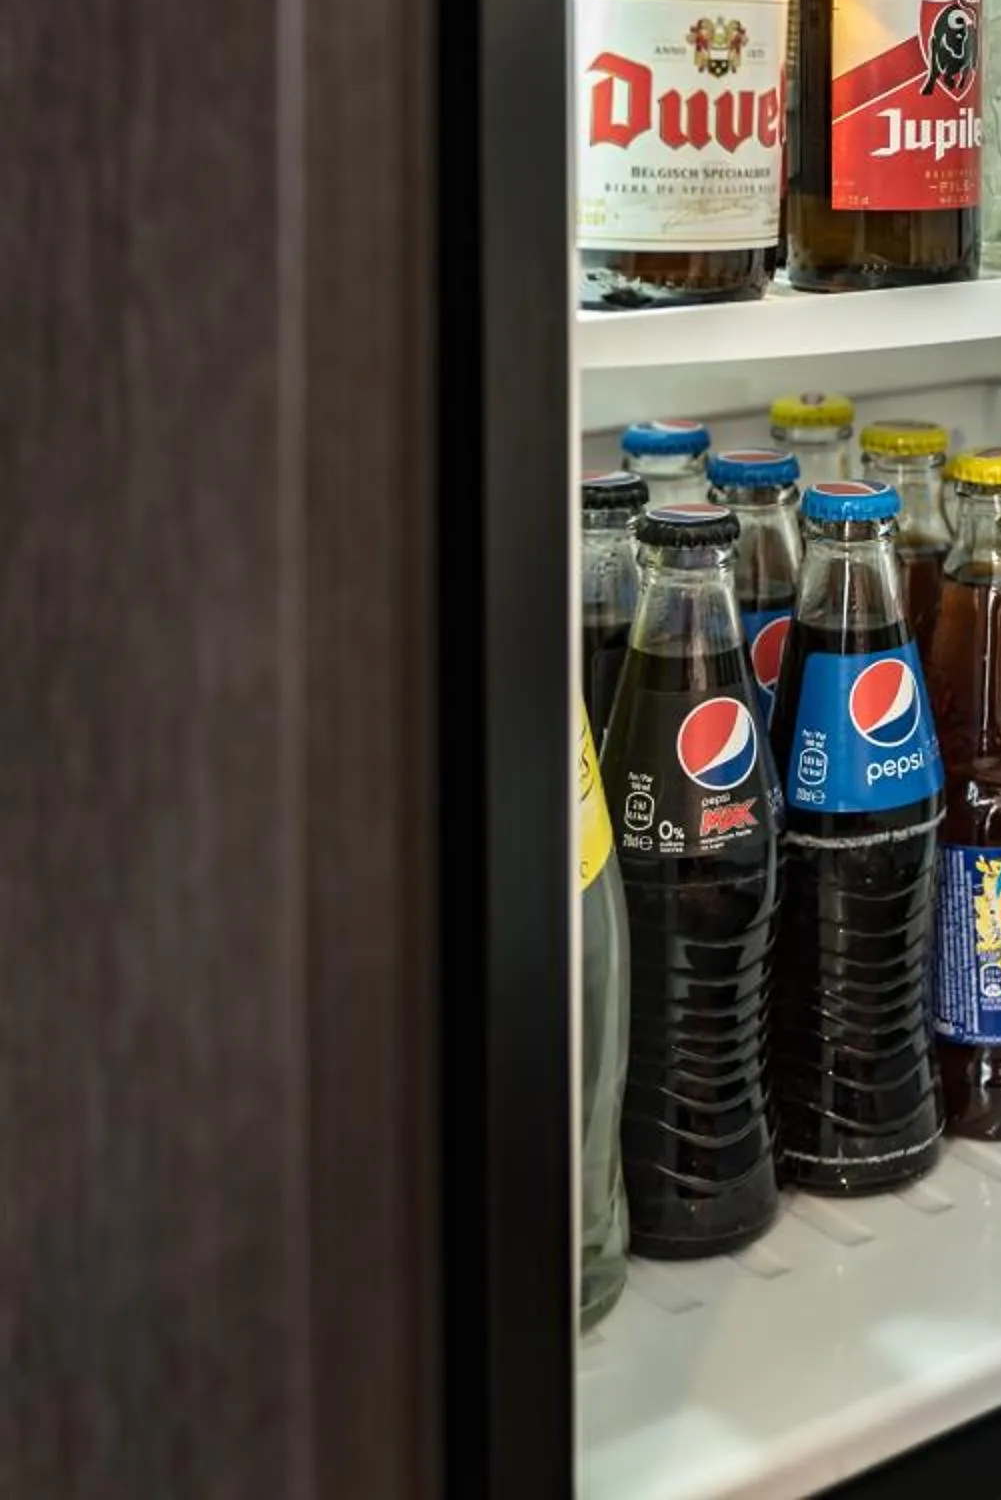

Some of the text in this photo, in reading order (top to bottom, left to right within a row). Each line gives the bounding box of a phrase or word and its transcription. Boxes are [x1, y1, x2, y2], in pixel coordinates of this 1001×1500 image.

[865, 748, 925, 787] pepsi
[658, 820, 685, 841] 0%
[700, 797, 760, 837] MAX
